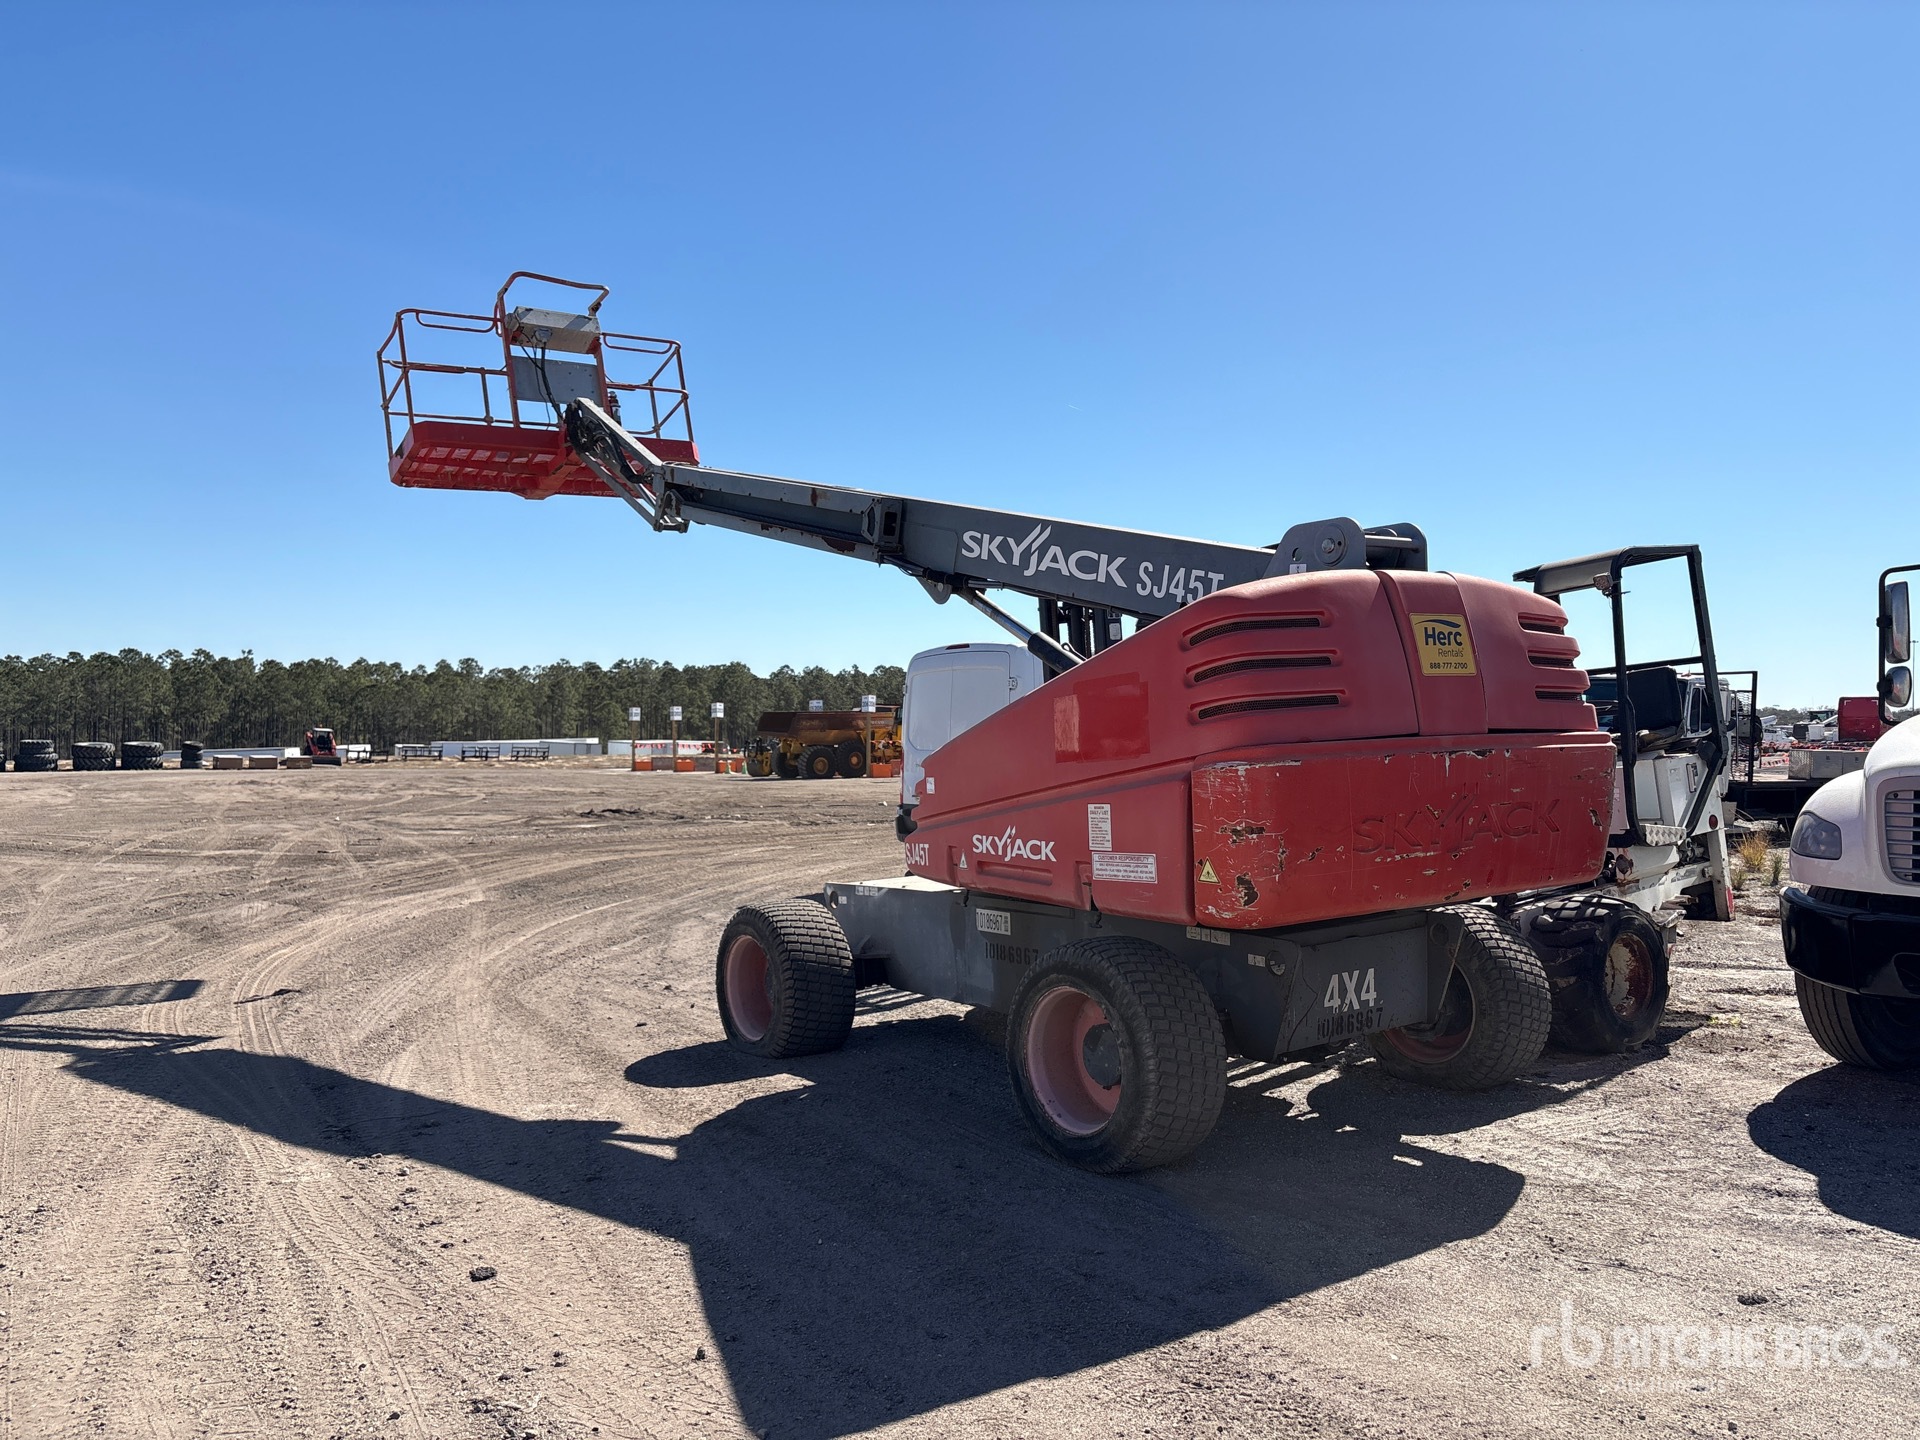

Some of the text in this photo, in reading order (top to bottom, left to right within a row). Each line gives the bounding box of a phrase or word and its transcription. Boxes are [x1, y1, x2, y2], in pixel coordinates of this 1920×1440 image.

[961, 523, 1224, 603] SKYJACK SJ45T
[1424, 627, 1463, 646] Herc
[1438, 648, 1464, 658] Rentals
[1430, 662, 1468, 670] 888-777-2700
[1353, 782, 1560, 853] SKYJACK
[905, 843, 929, 866] SJ45T
[972, 825, 1057, 862] SKYJACK
[976, 911, 1003, 932] 10186967
[985, 942, 1039, 965] 10186967
[1324, 967, 1377, 1014] 4X4
[1317, 1007, 1384, 1040] 10186967
